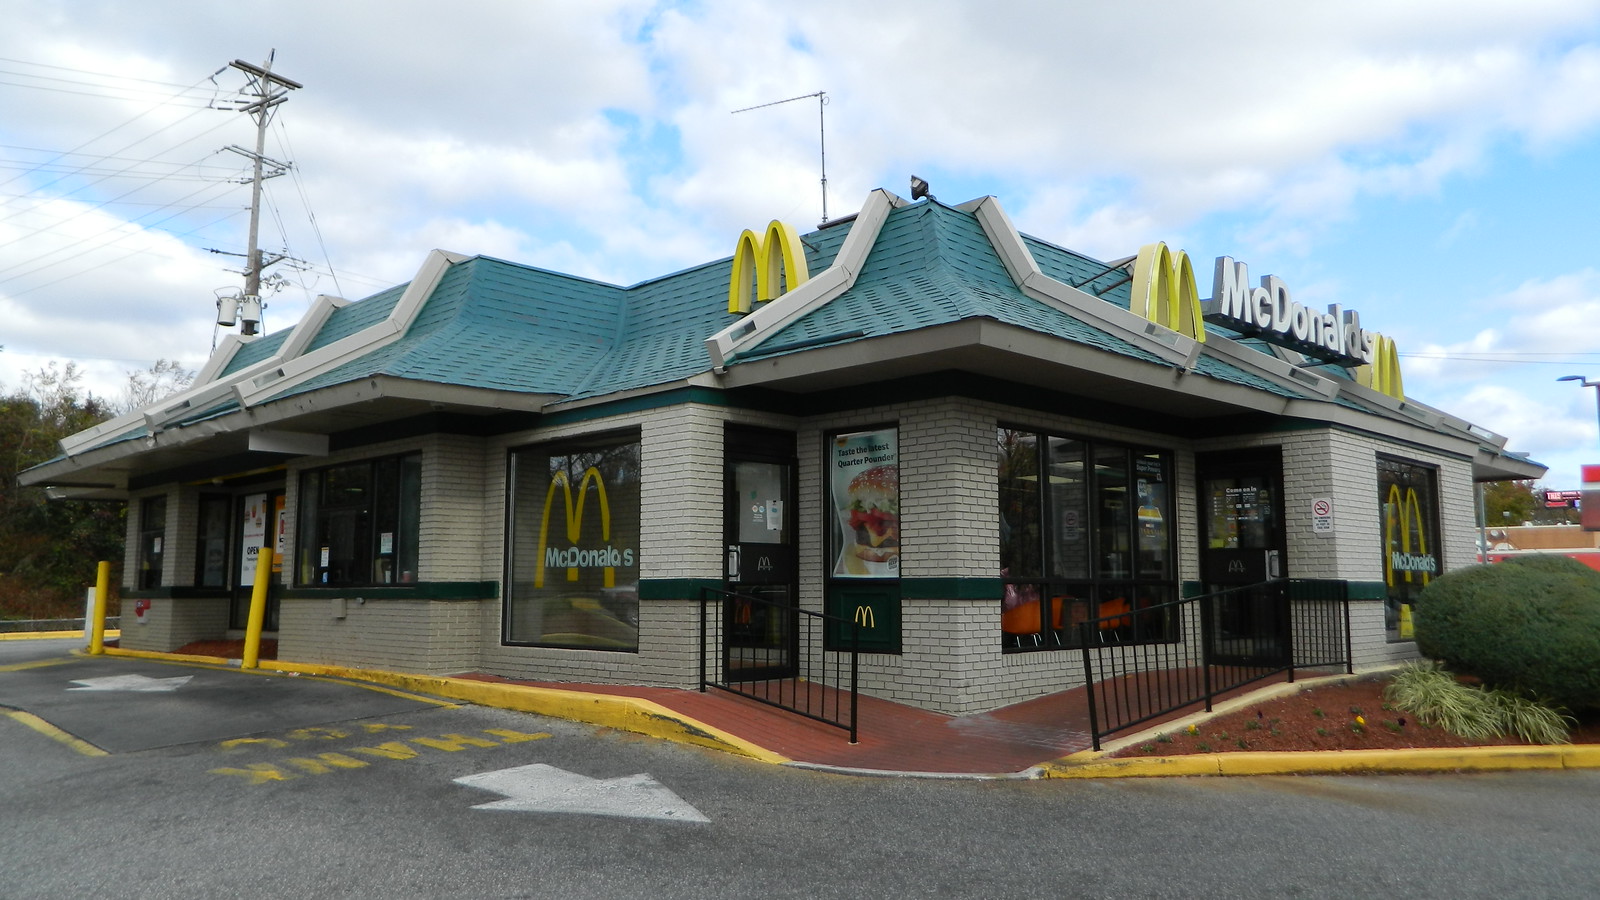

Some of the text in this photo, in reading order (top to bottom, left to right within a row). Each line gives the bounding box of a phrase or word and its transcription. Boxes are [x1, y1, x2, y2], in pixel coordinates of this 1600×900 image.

[838, 449, 855, 457] Taste
[868, 443, 890, 452] latest
[837, 459, 863, 469] Quarter
[246, 546, 259, 555] OPEN
